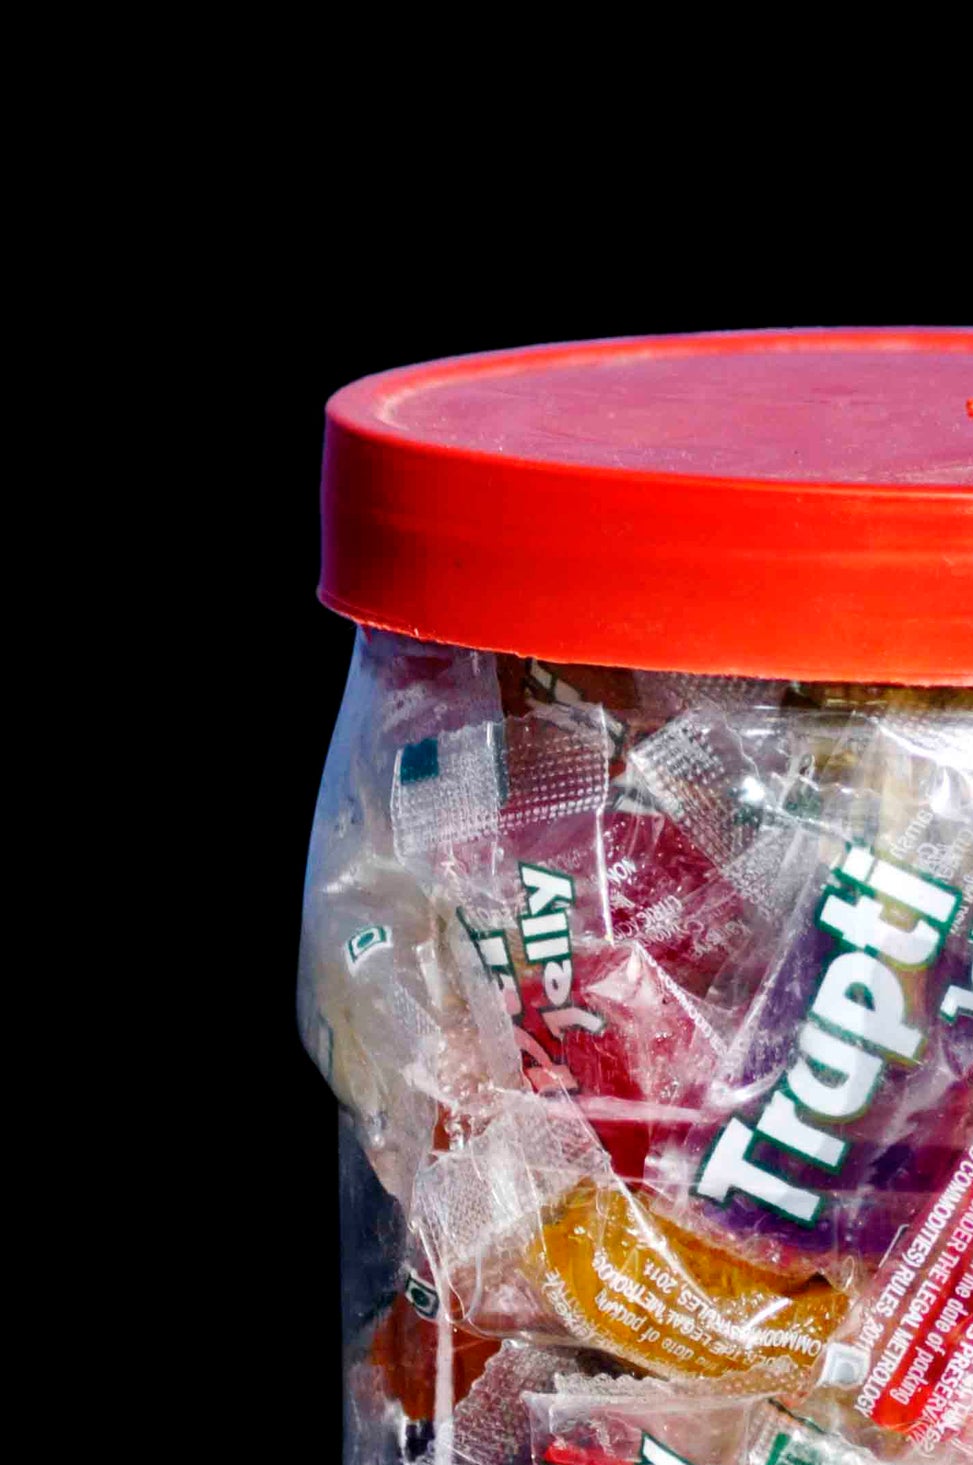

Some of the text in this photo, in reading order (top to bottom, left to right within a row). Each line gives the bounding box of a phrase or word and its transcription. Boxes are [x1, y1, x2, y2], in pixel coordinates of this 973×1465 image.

[518, 861, 605, 1038] Jelly
[686, 839, 964, 1226] Trupti
[927, 1247, 961, 1284] THE
[898, 1277, 943, 1333] LEGAL
[931, 1296, 970, 1338] date
[847, 1324, 920, 1420] METROLOGY
[922, 1330, 951, 1357] of
[886, 1345, 941, 1410] packing
